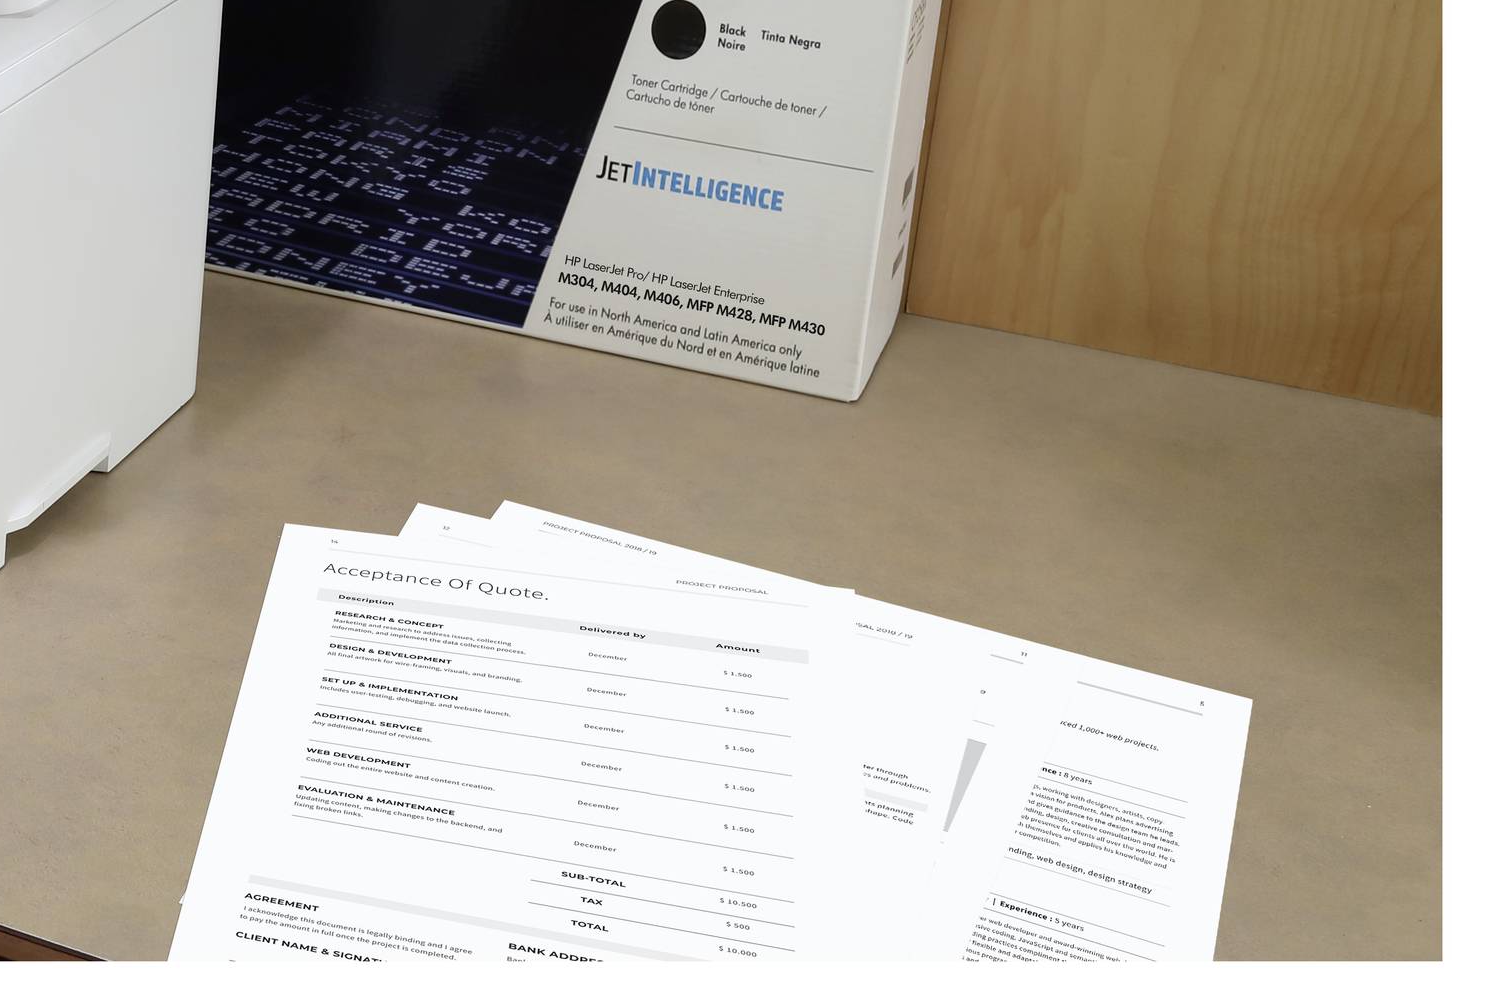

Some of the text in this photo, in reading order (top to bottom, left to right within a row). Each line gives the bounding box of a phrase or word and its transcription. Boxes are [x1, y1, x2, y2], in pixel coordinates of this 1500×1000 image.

[719, 23, 747, 38] Black
[761, 29, 821, 50] Tinta Negra
[717, 37, 746, 52] Noire
[626, 88, 672, 107] Cartucho
[673, 96, 687, 110] de
[632, 73, 828, 119] Toner Cartridge / Cartouche de toner /
[210, 187, 473, 259] ADRID
[564, 254, 582, 267] HP
[583, 258, 625, 276] LaserJet
[651, 272, 669, 285] HP
[670, 276, 712, 294] LaserJet
[713, 285, 765, 305] Enterprise
[558, 271, 598, 293] M304,
[601, 280, 641, 301] M404,
[643, 289, 684, 310] M406,
[686, 298, 715, 313] MFP
[716, 304, 756, 324] M428,
[759, 312, 787, 328] MFP
[788, 318, 826, 336] M430
[547, 296, 803, 361] For use in North America and Latin America only
[555, 315, 590, 331] utiliser
[591, 324, 605, 334] en
[606, 325, 658, 347] Amérique
[660, 335, 674, 349] du
[676, 338, 705, 355] Nord
[706, 347, 717, 357] et
[719, 350, 733, 361] en
[734, 351, 788, 372] Amérique
[789, 360, 820, 378] latine
[323, 563, 549, 601] Acceptance Of Quote.
[338, 594, 395, 606] Description
[335, 610, 386, 622] RESEARCH
[397, 619, 445, 629] CONCEPT
[579, 626, 646, 640] Delivered by
[329, 643, 366, 653] DESIGN
[377, 650, 453, 665] DEVELOPMENT
[588, 652, 628, 662] December
[716, 643, 761, 654] Amount
[368, 683, 459, 701] IMPLEMENTATION
[586, 687, 627, 697] December
[314, 711, 423, 733] ADDITIONAL SERVICE
[584, 723, 624, 734] December
[1106, 733, 1124, 742] web
[1124, 738, 1159, 752] projects.
[306, 747, 411, 769] WEB DEVELOPMENT
[581, 761, 622, 772] December
[298, 784, 364, 801] EVALUATION
[376, 798, 455, 816] MAINTENANCE
[577, 800, 619, 811] December
[877, 804, 914, 818] planning
[573, 840, 617, 852] December
[561, 871, 626, 888] SUB-TOTAL
[1036, 855, 1153, 895] web design, design strategy
[244, 893, 320, 912] AGREEMENT
[580, 896, 603, 906] TAX
[1000, 900, 1048, 921] Experience
[1062, 921, 1084, 932] years
[248, 907, 299, 922] acknowledge
[316, 920, 357, 933] document
[366, 929, 394, 941] legally
[394, 934, 426, 947] binding
[449, 946, 473, 955] agree
[571, 919, 609, 933] TOTAL
[734, 923, 751, 931] 500
[235, 931, 279, 945] CLIENT
[281, 940, 318, 953] NAME
[321, 948, 330, 956] &
[508, 943, 546, 956] BANK
